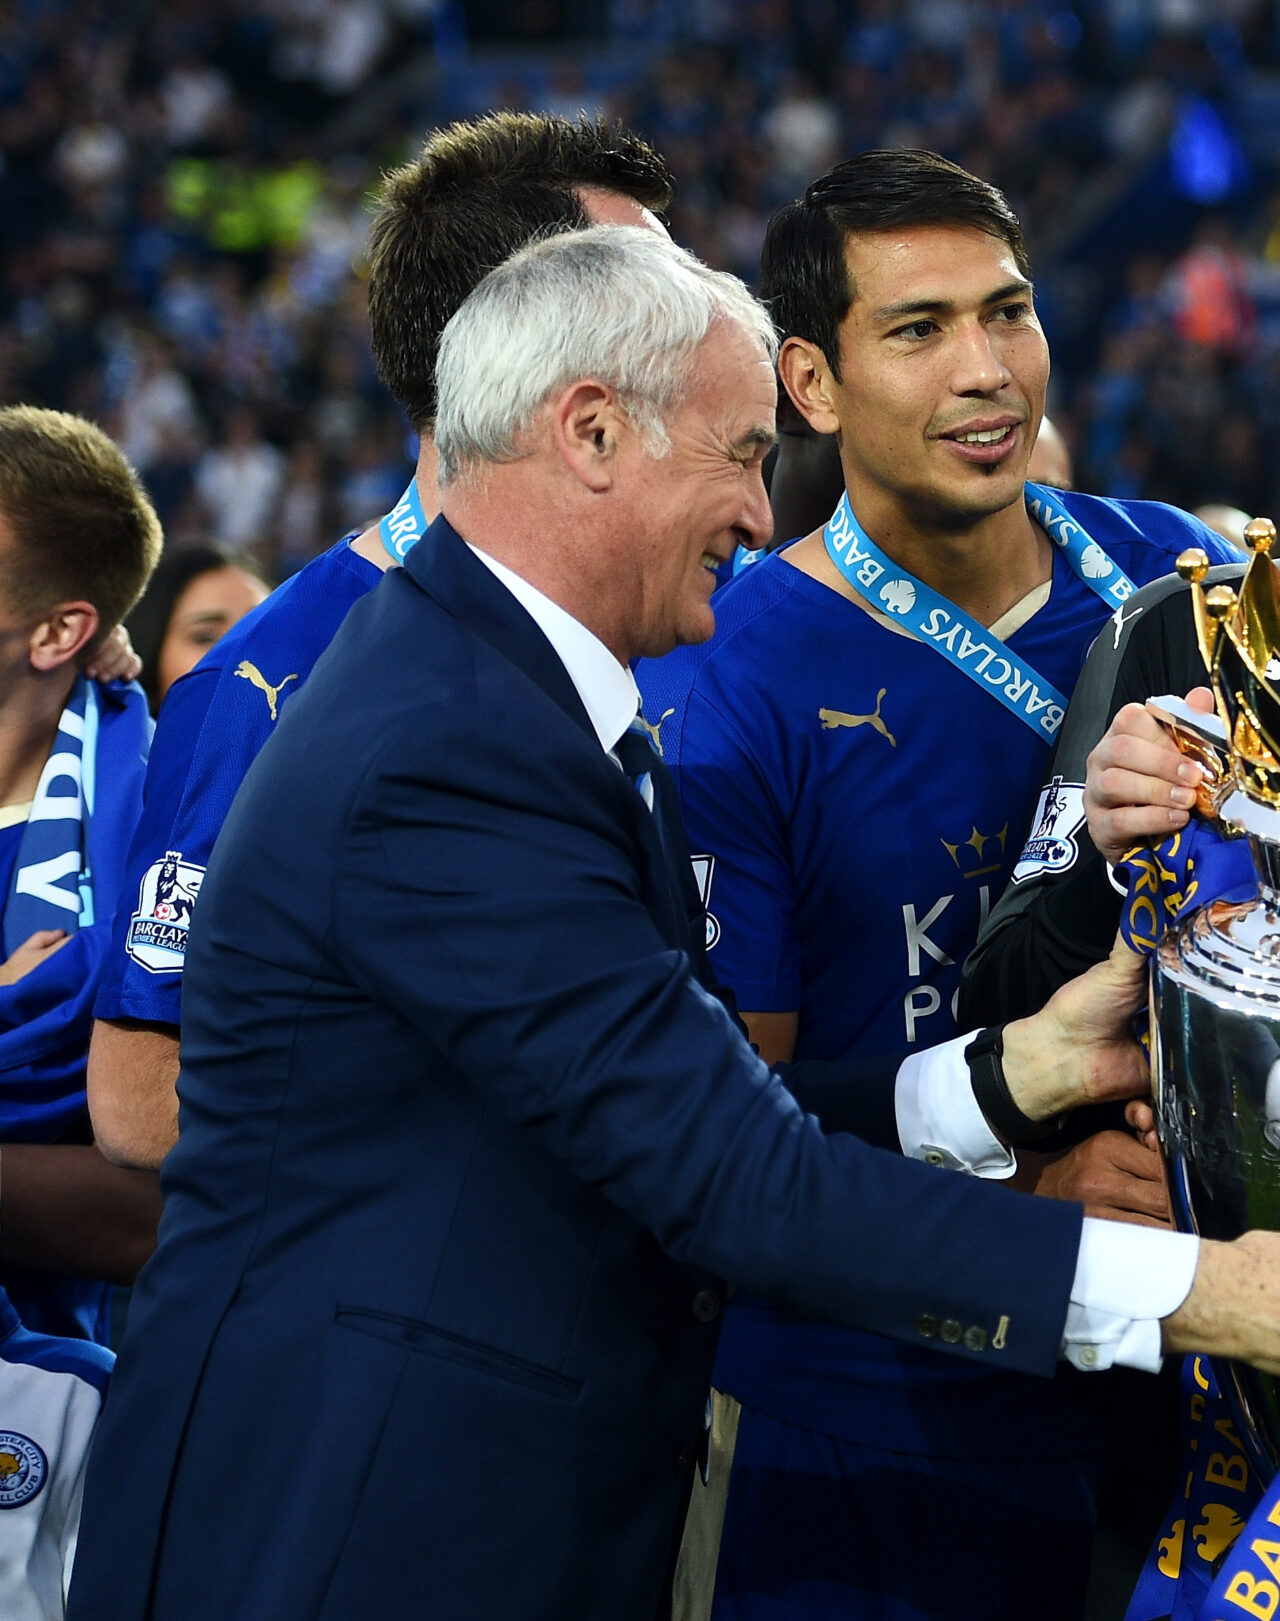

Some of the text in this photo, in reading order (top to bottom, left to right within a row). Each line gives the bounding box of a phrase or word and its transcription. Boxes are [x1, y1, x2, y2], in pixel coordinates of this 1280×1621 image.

[388, 490, 421, 556] ARC
[919, 607, 1065, 734] BARCLAYS
[156, 939, 186, 952] LEAGU
